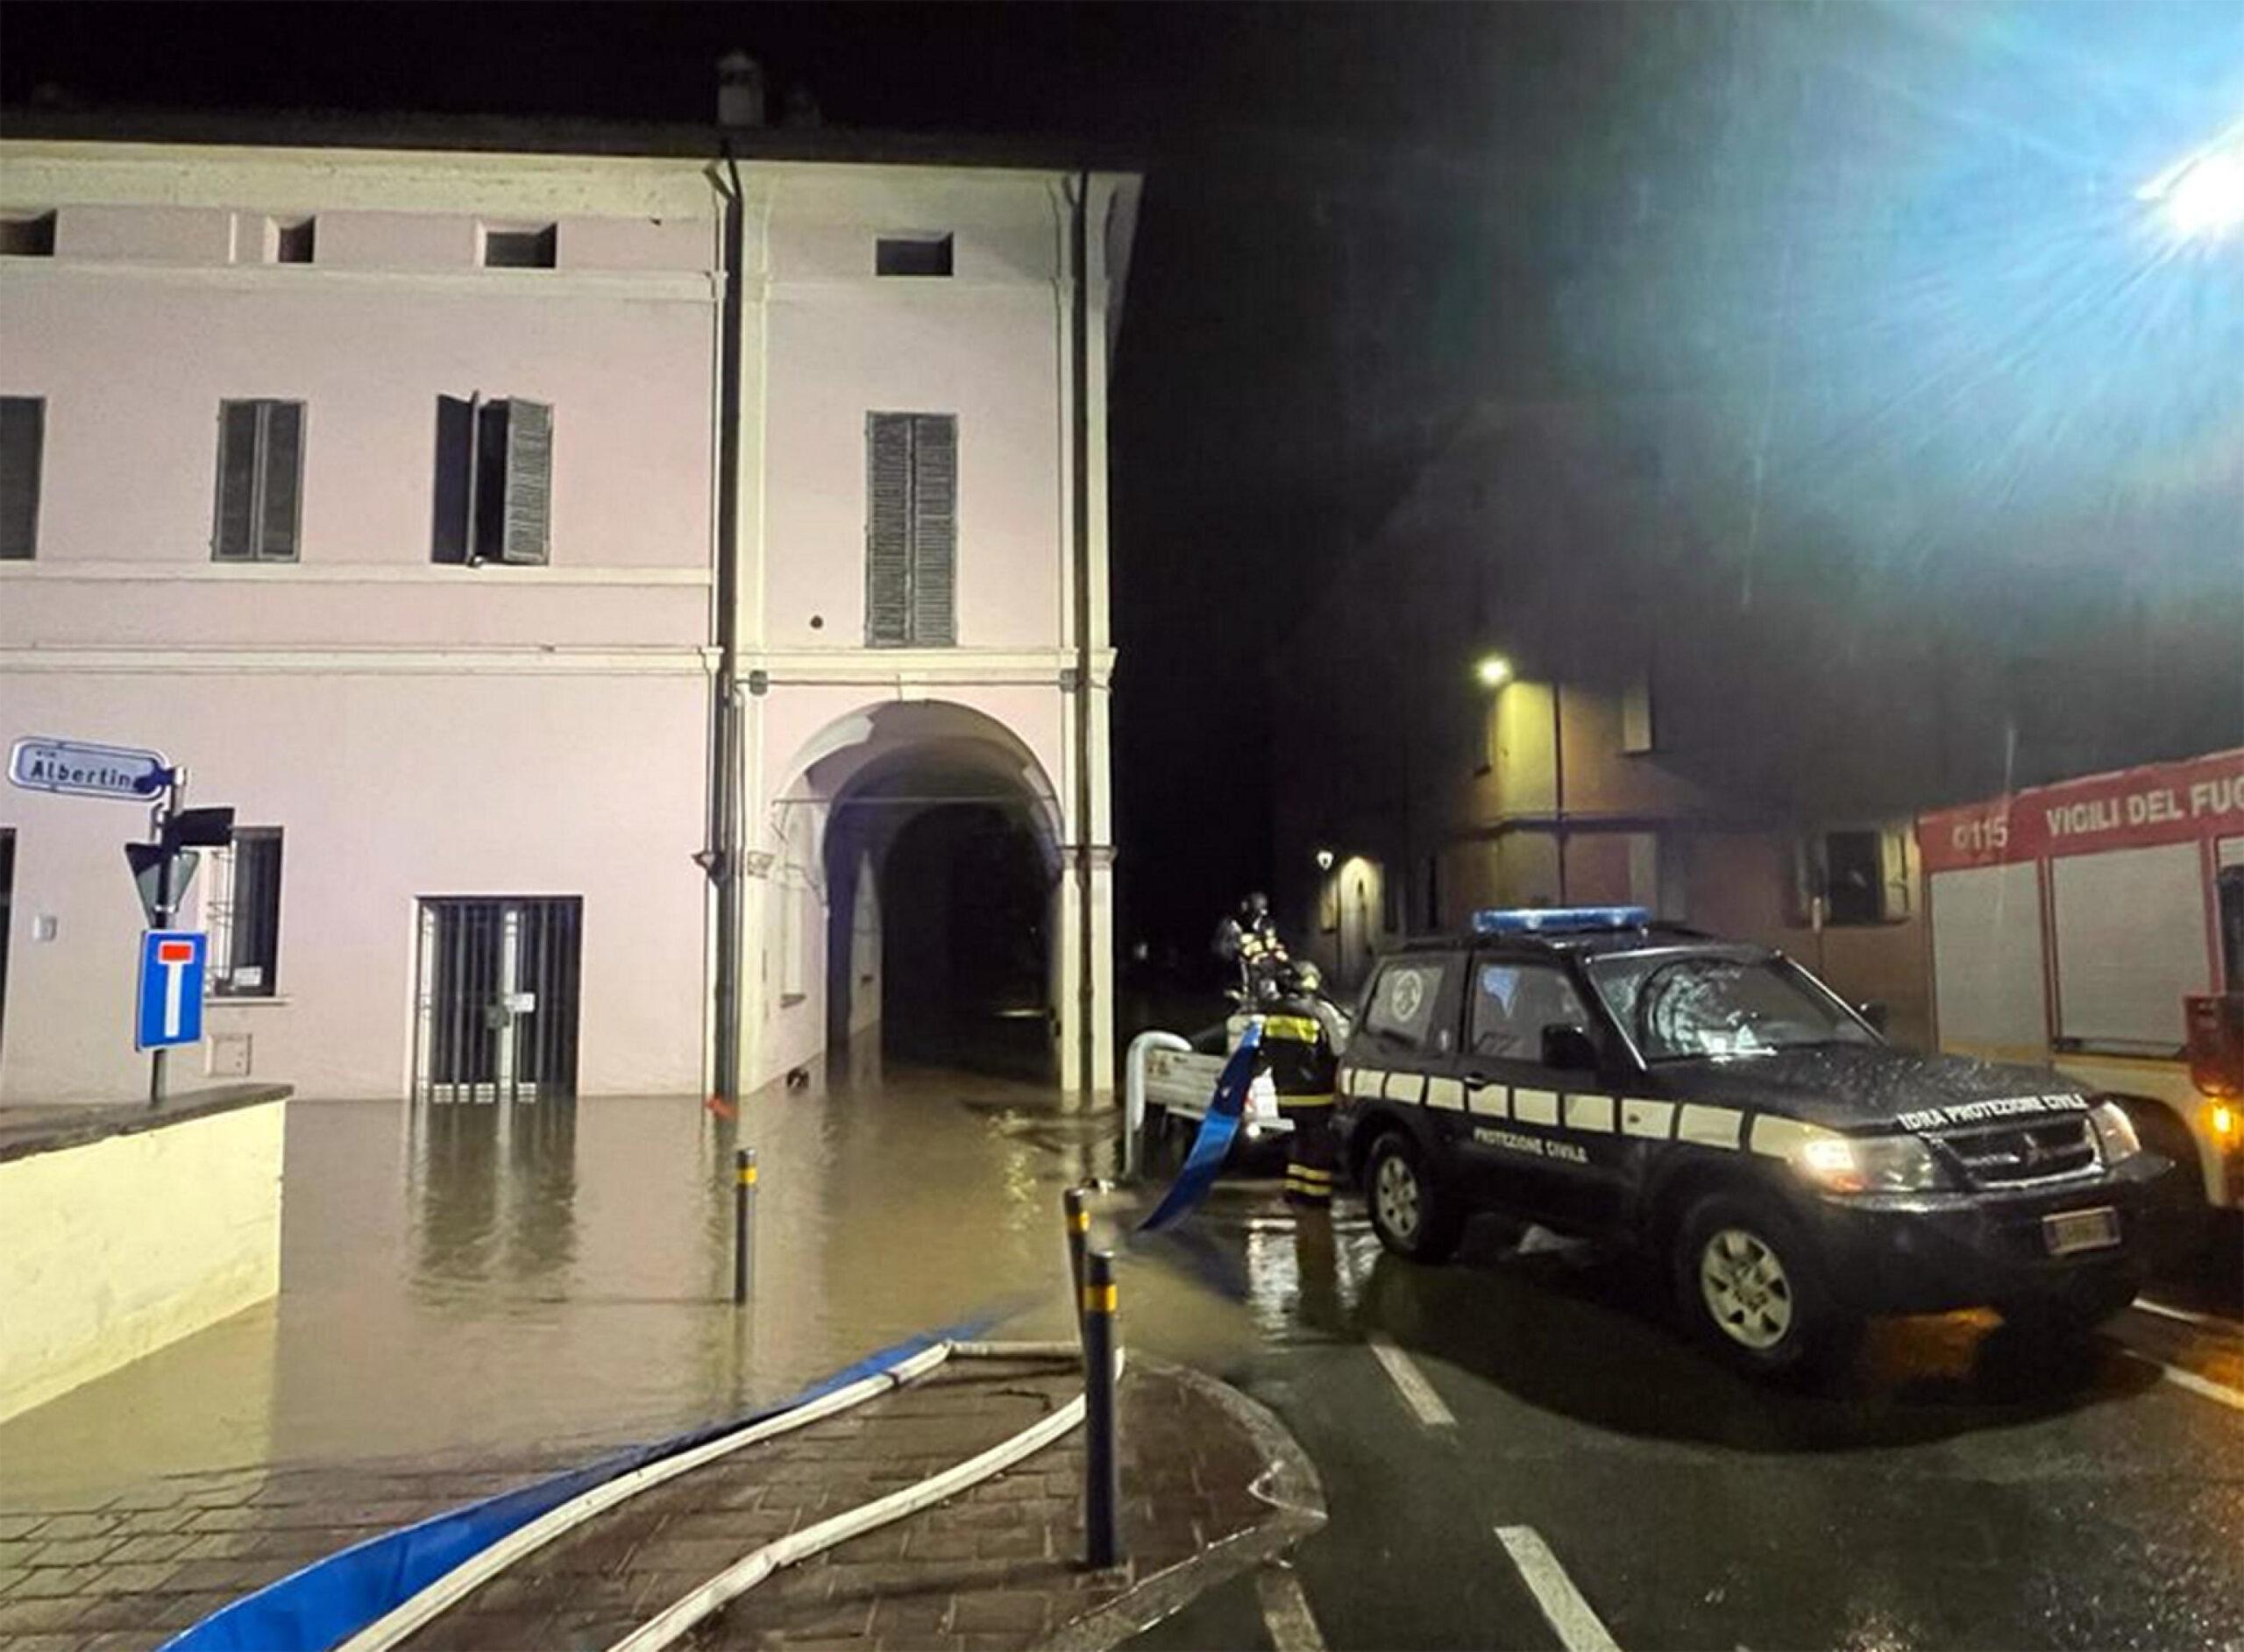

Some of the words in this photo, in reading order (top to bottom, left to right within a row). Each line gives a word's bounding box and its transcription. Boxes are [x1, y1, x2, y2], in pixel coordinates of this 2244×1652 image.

[31, 759, 135, 790] Albertin
[2046, 798, 2121, 837] VIGILI
[2127, 788, 2184, 826] DEL
[1943, 1096, 2048, 1123] PROTEZIONE
[2042, 1093, 2089, 1110] CIVILE
[1473, 1127, 1544, 1155] PROTEZIONE
[1545, 1139, 1589, 1163] CIVILE
